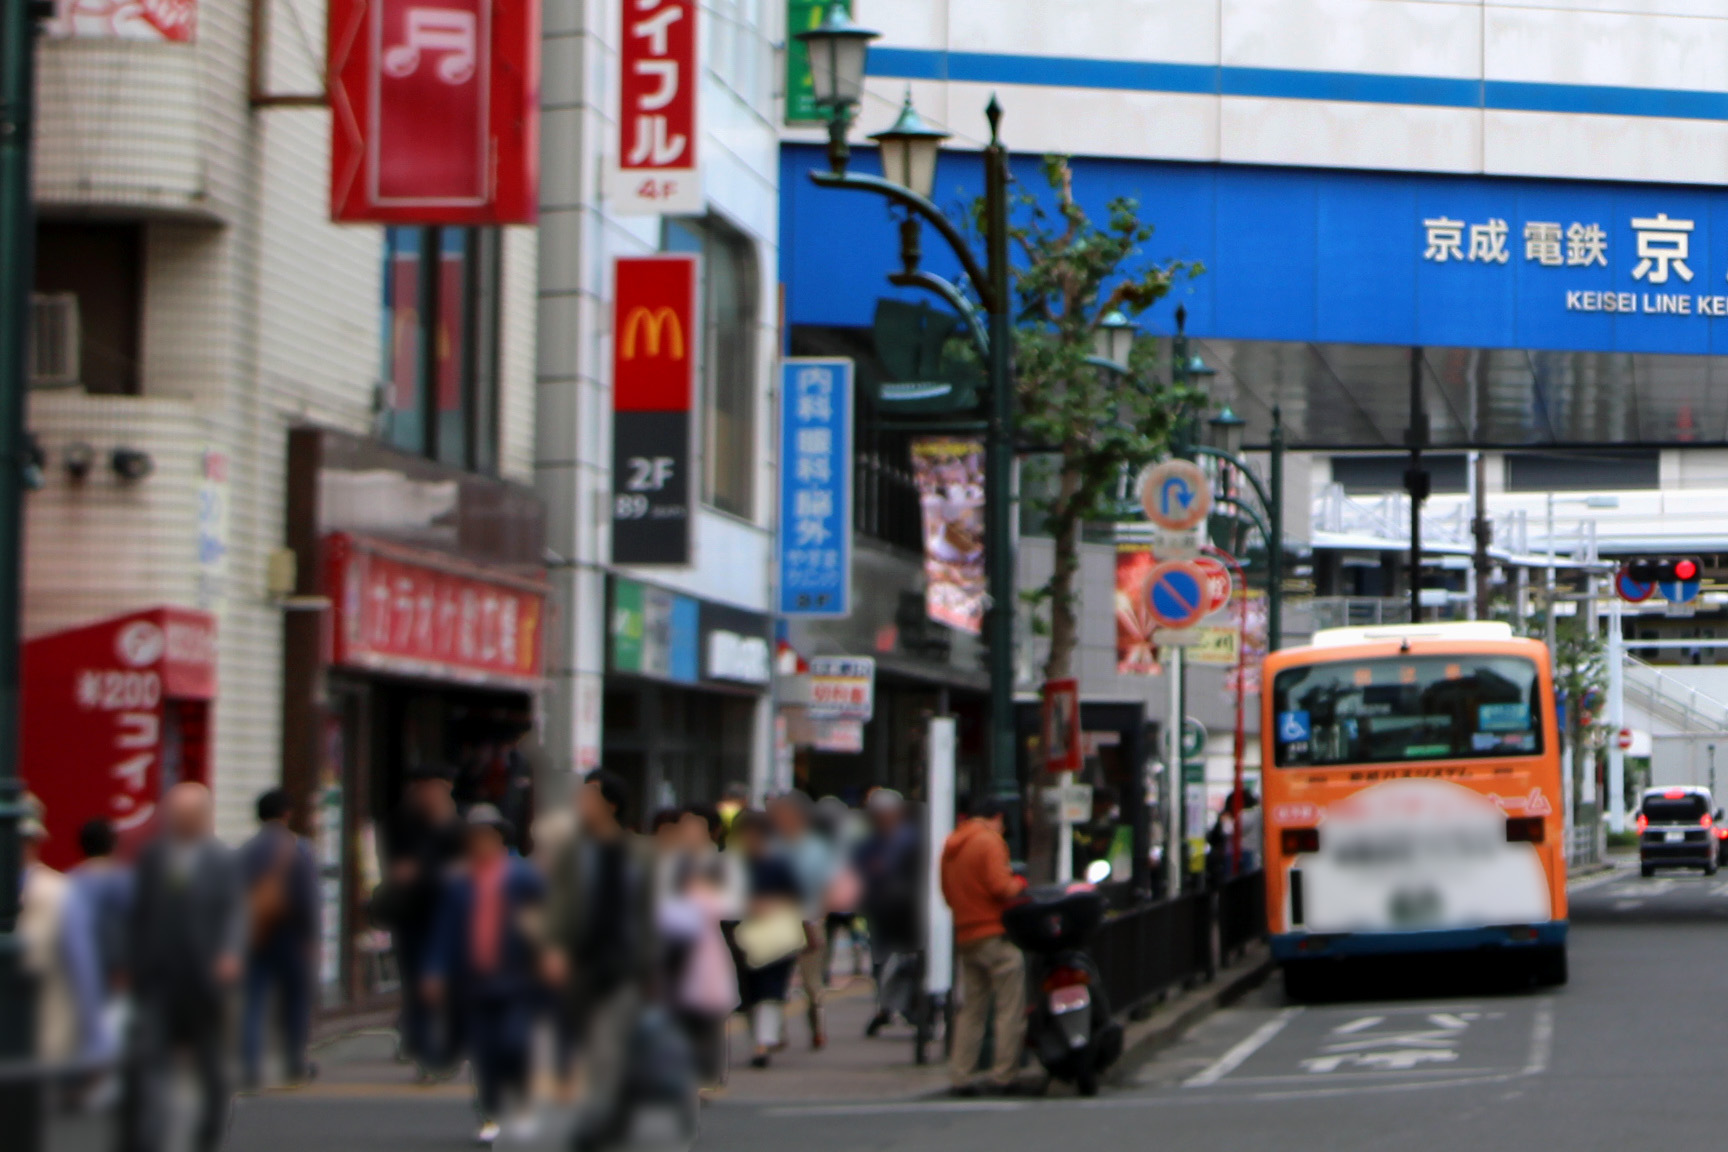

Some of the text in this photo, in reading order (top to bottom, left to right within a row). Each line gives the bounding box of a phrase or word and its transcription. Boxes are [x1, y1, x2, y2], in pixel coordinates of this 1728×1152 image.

[636, 177, 678, 201] 4F
[1566, 290, 1637, 313] KEISEI
[1642, 294, 1691, 315] LINE
[628, 457, 675, 491] 2F
